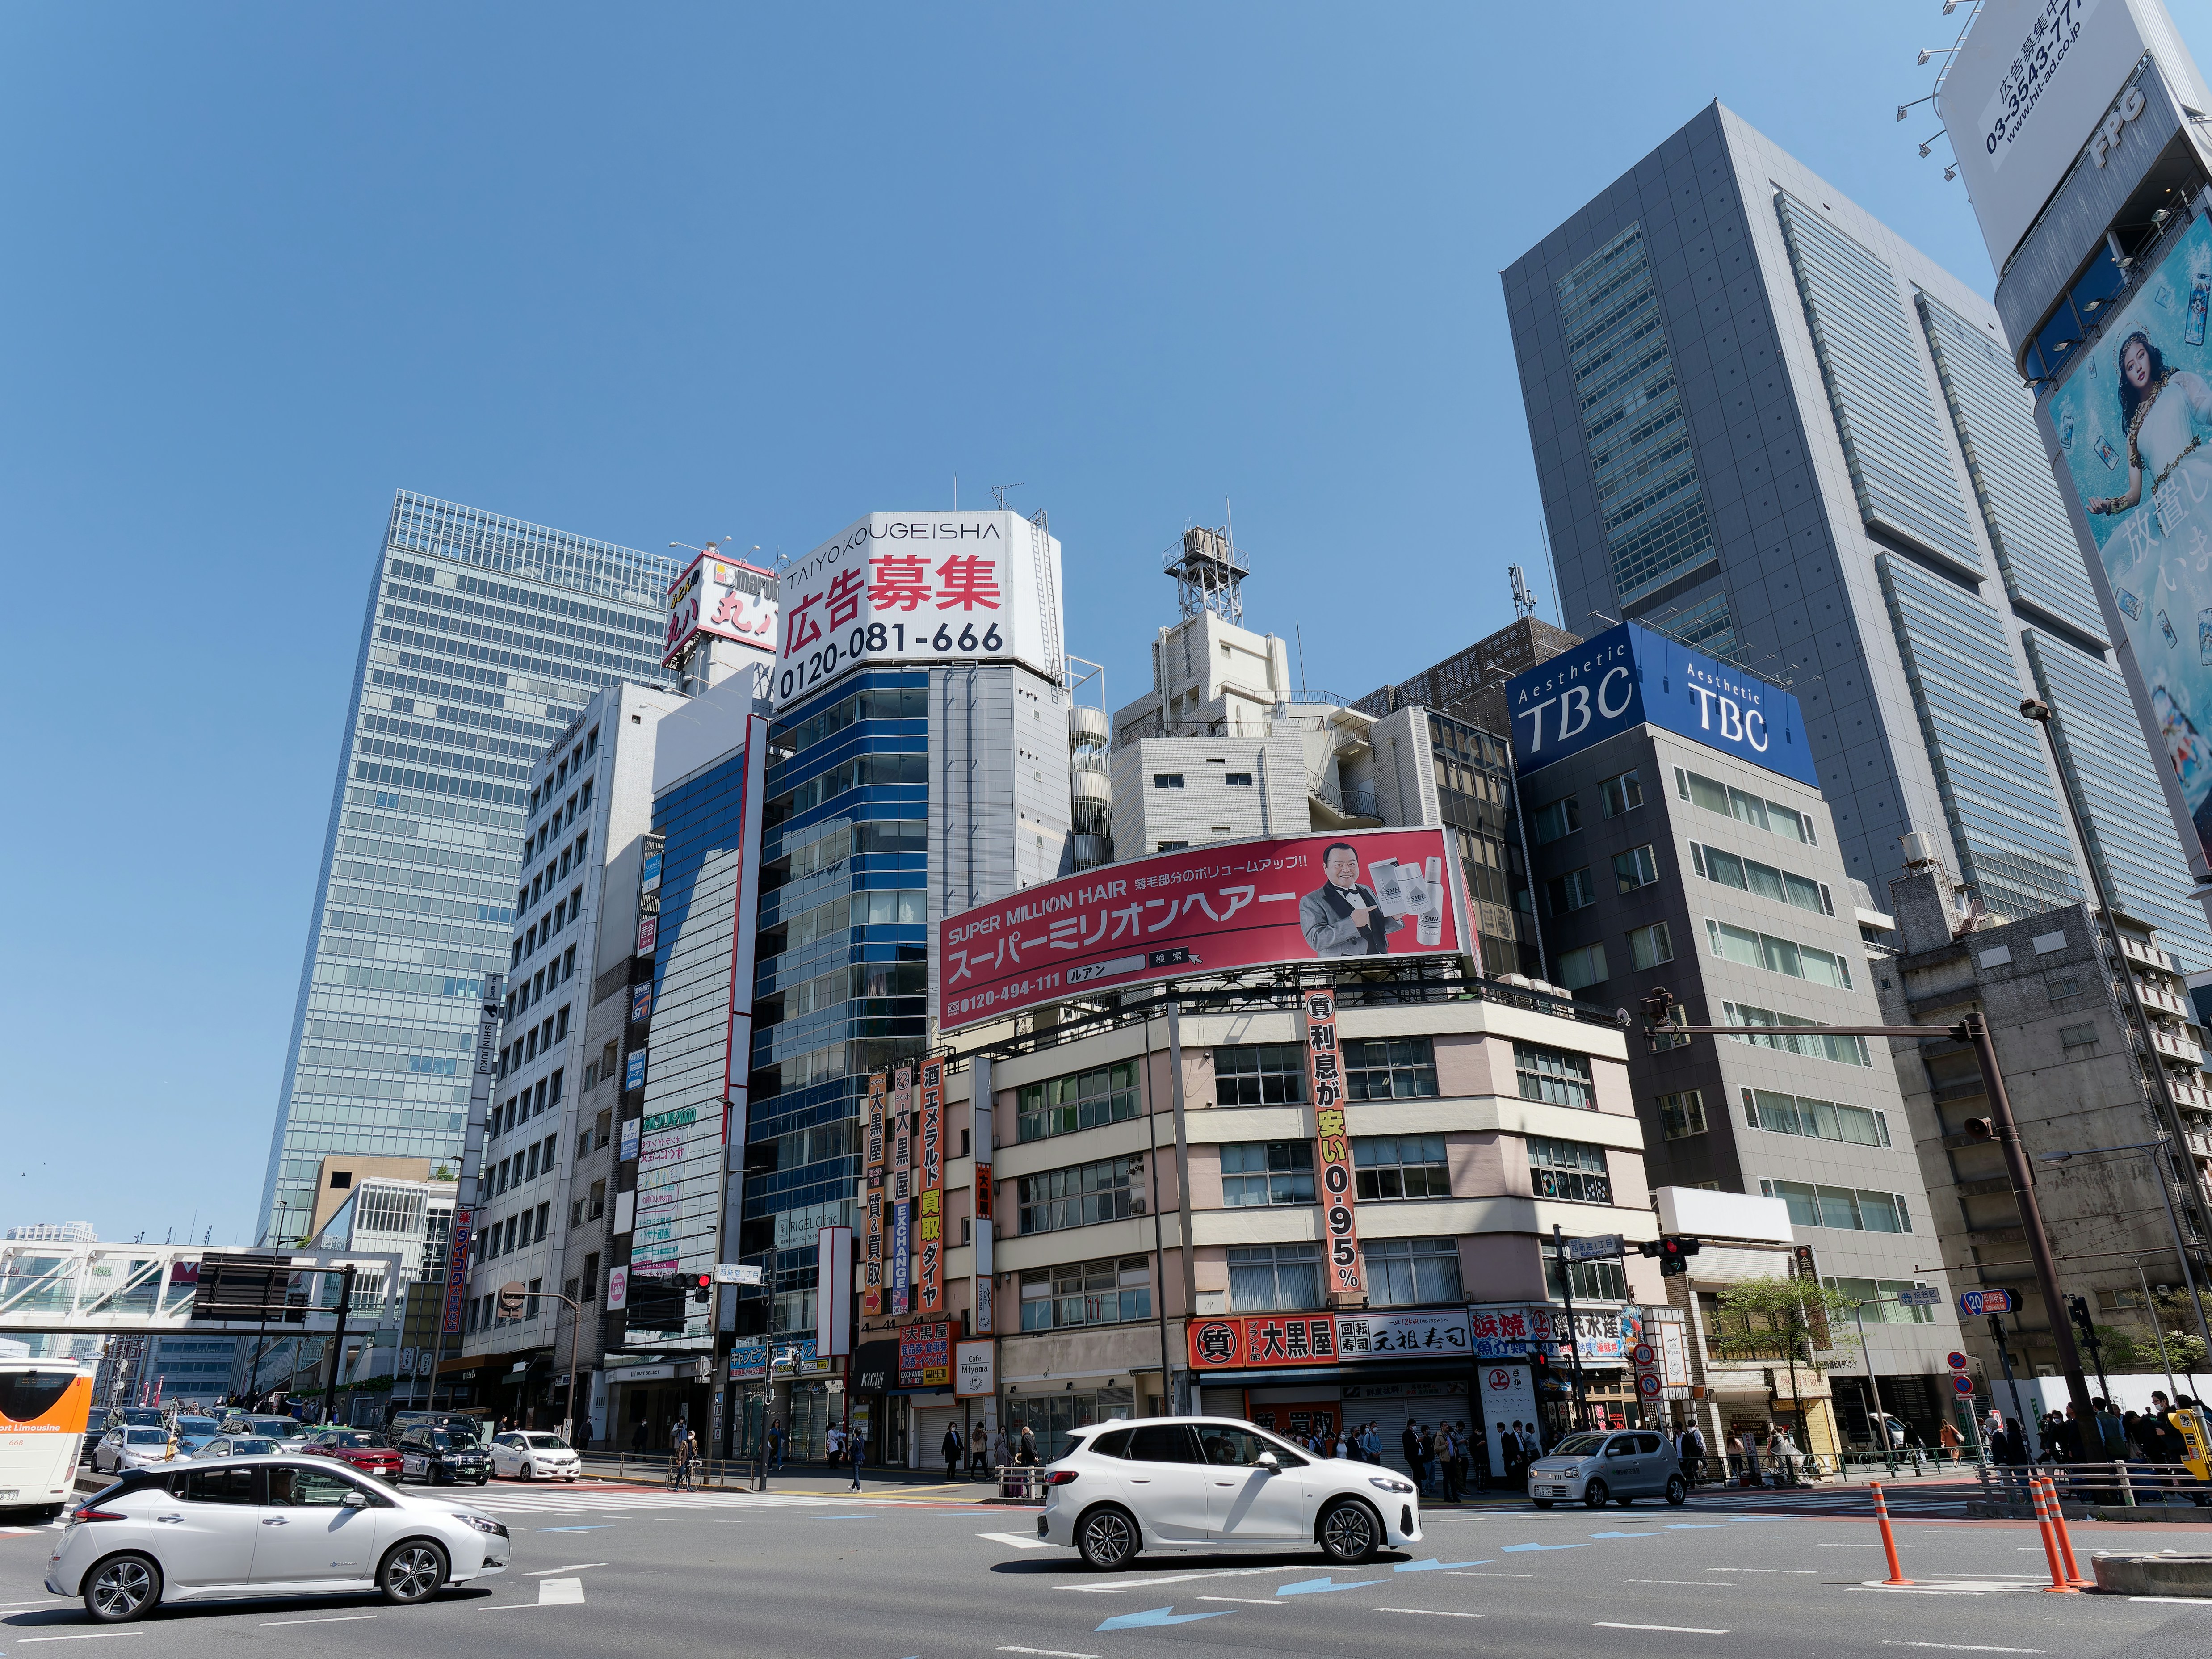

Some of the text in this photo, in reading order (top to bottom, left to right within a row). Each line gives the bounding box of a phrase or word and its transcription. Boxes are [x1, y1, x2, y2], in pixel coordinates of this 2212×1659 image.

[1999, 0, 2057, 104] 広告募集中
[1986, 0, 2082, 154] 03-3543-77
[2006, 21, 2080, 143] www.hit-ad.co.jp
[2088, 86, 2145, 168] FPG
[787, 522, 1001, 590] TAIYOKOUGEISHA
[783, 554, 1002, 659] 広告募集
[664, 598, 698, 651] 丸八
[780, 622, 1003, 700] 0120-081-666
[1519, 643, 1624, 705] Aesthetic
[1687, 663, 1760, 705] Aesthetic
[1517, 666, 1633, 754] TBC
[1688, 682, 1768, 752] TBC
[647, 881, 655, 890] 9F
[1134, 855, 1308, 892] 薄毛部分のボリュームアップ!!
[949, 879, 1127, 946] SUPER MILLION HAIR
[948, 885, 1296, 985] スーパーミリオンヘアー
[1154, 950, 1184, 966] 検索
[1070, 965, 1105, 982] ルアン
[961, 972, 1060, 1013] 0120-494-111
[479, 1025, 492, 1071] SHINJUKU
[630, 1051, 644, 1062] AEON
[627, 1069, 644, 1080] イーオン
[629, 1061, 643, 1072] 英会話
[870, 1077, 886, 1087] チケット
[868, 1087, 885, 1164] 大黒屋
[894, 1102, 910, 1201] 大黒屋
[790, 1214, 837, 1233] RIGEL Clinic
[866, 1193, 882, 1287] 質&買取
[896, 1205, 908, 1289] EXCHANGE
[1571, 1239, 1613, 1253] 西新宿1丁目
[451, 1229, 470, 1285] ダイコク
[720, 1269, 759, 1278] 西新宿1丁目
[612, 1284, 623, 1296] Labo
[1914, 1290, 1937, 1299] 渋谷区
[1969, 1295, 1982, 1310] 20
[905, 1323, 948, 1342] 大黒屋
[1340, 1322, 1368, 1336] 回転
[1373, 1327, 1466, 1351] 元祖寿司
[1473, 1313, 1526, 1339] 浜焼
[901, 1340, 948, 1357] 商品券・食事券
[1200, 1327, 1234, 1360] 質
[1247, 1321, 1262, 1361] ブランド館
[1261, 1319, 1334, 1360] 大黒屋
[1343, 1337, 1369, 1351] 寿司
[1477, 1340, 1527, 1355] 魚介類
[901, 1352, 948, 1369] JR券・イベント券
[968, 1355, 982, 1363] Cafe
[1638, 1349, 1650, 1359] 40
[901, 1370, 923, 1378] EXCHANGE
[961, 1365, 988, 1376] Miyama
[13, 1424, 61, 1432] Limousine
